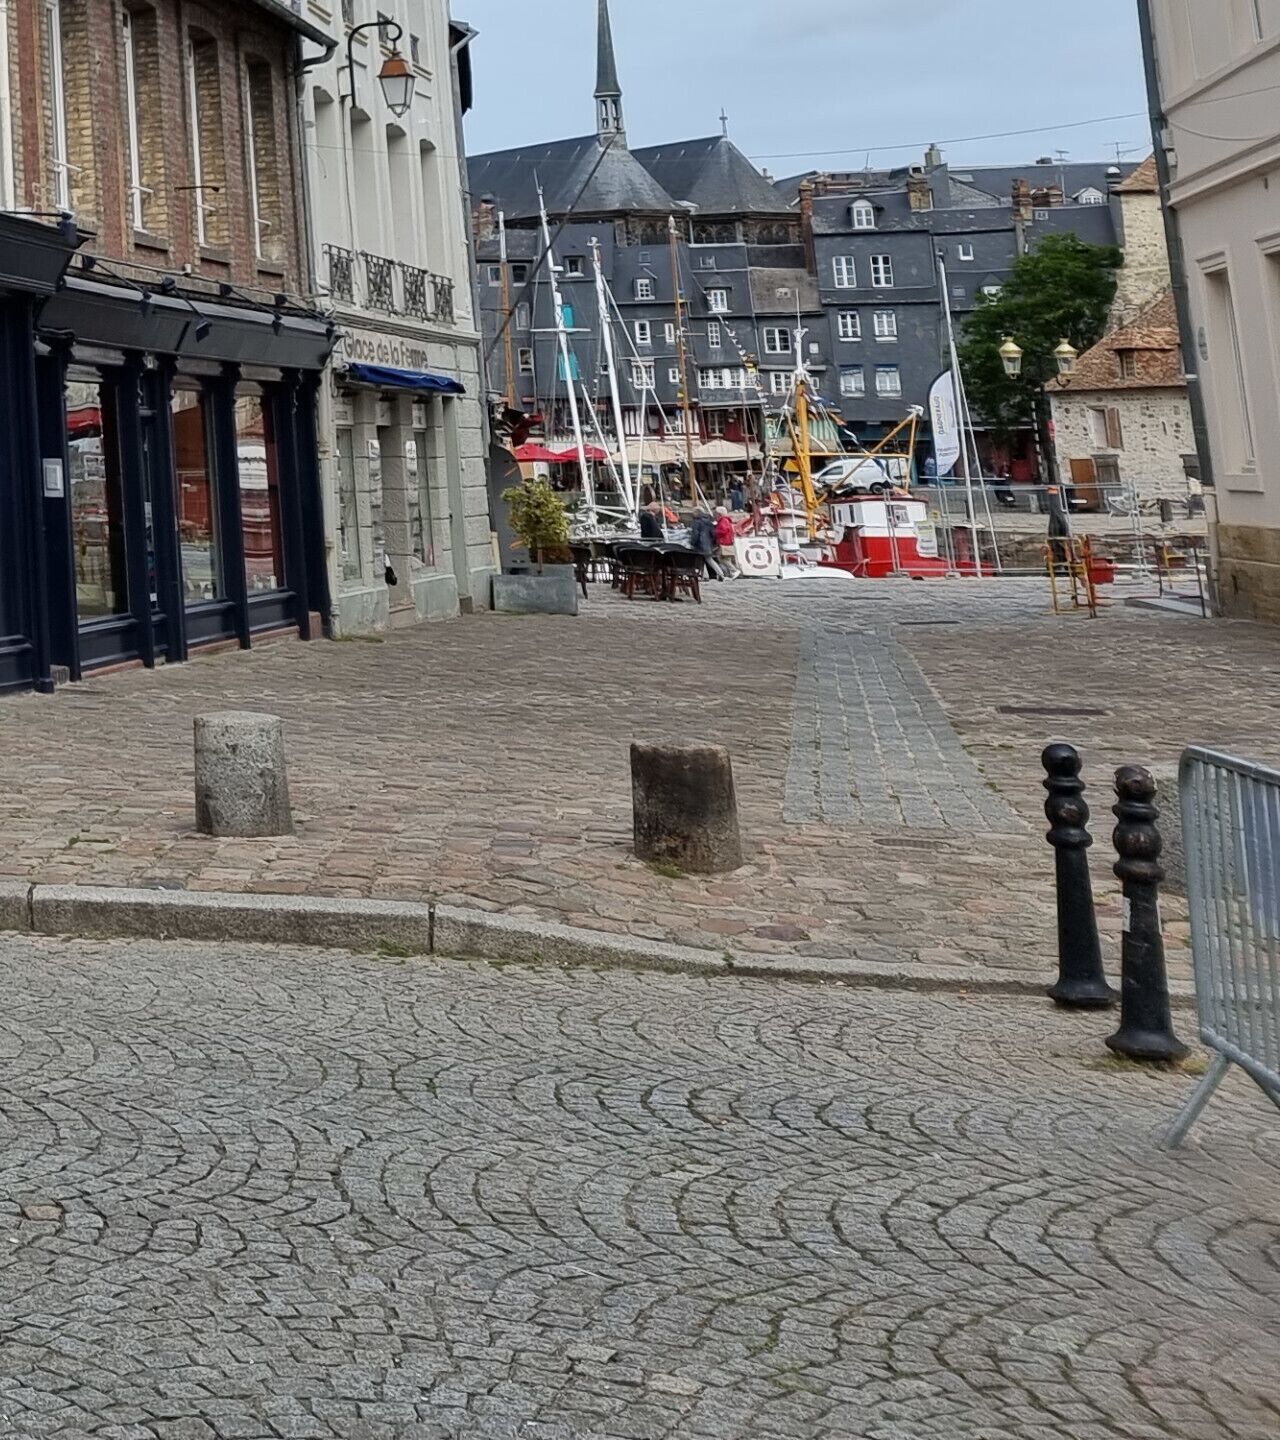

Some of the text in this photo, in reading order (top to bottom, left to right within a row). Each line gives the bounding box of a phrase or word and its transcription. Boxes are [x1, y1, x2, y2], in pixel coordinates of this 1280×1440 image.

[344, 331, 375, 361] Glace
[376, 338, 390, 363] de
[390, 340, 400, 365] la
